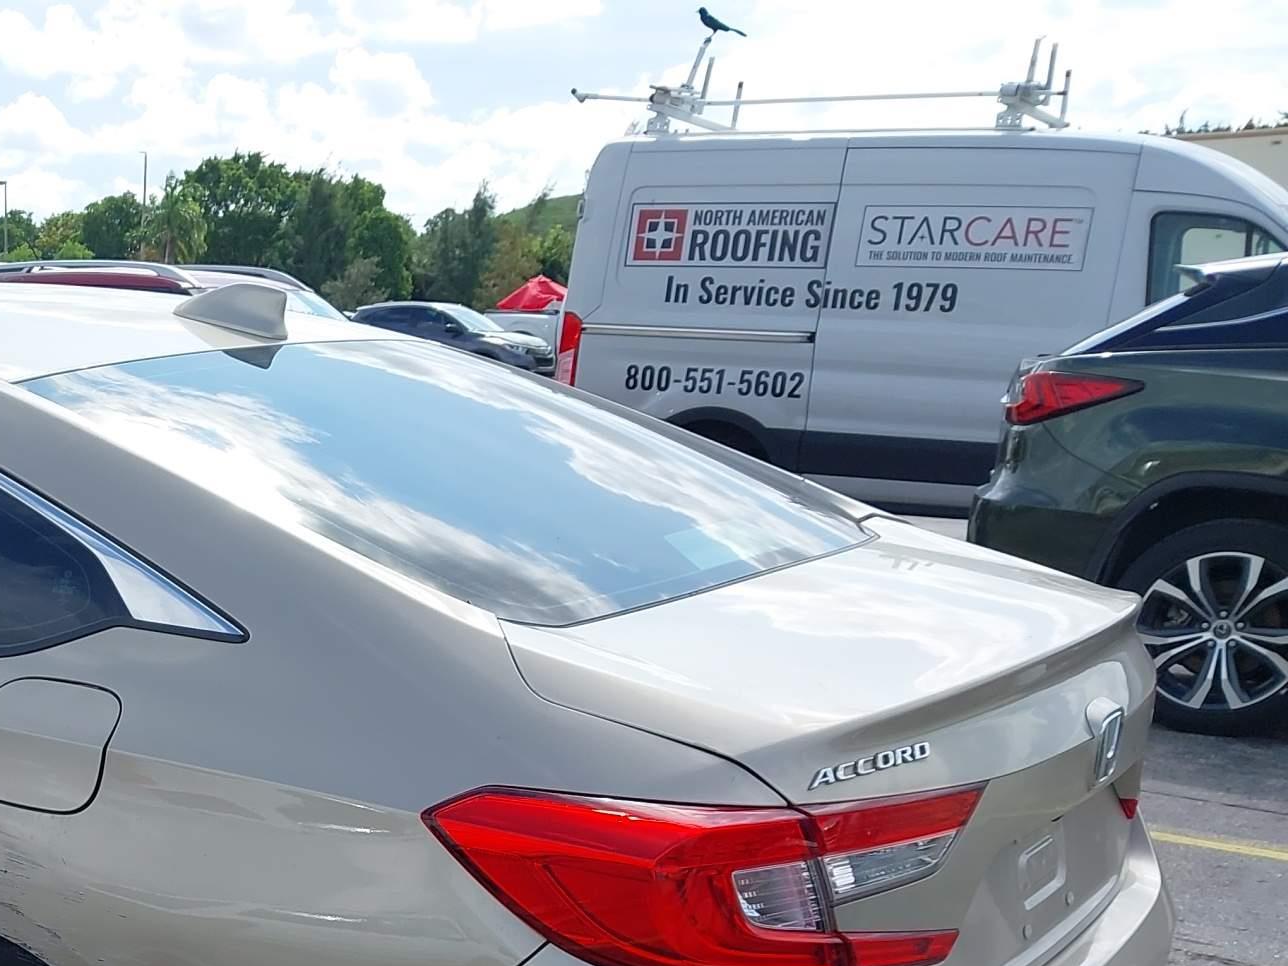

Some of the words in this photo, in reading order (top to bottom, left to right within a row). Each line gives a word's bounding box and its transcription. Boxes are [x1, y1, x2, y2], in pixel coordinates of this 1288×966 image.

[693, 209, 743, 226] NORTH
[747, 209, 827, 227] AMERICAN
[867, 215, 1073, 248] STARCARE
[688, 229, 822, 263] ROOFING
[869, 250, 883, 260] THE
[886, 250, 929, 261] SOLUTION
[931, 251, 942, 261] TO
[944, 251, 982, 262] MODERN
[983, 252, 1008, 263] ROOF
[664, 275, 689, 304] In
[698, 276, 795, 307] Service
[805, 279, 881, 310] Since
[892, 281, 958, 313] 1979
[625, 364, 805, 399] 800-551-5602
[807, 741, 931, 791] ACCORD
